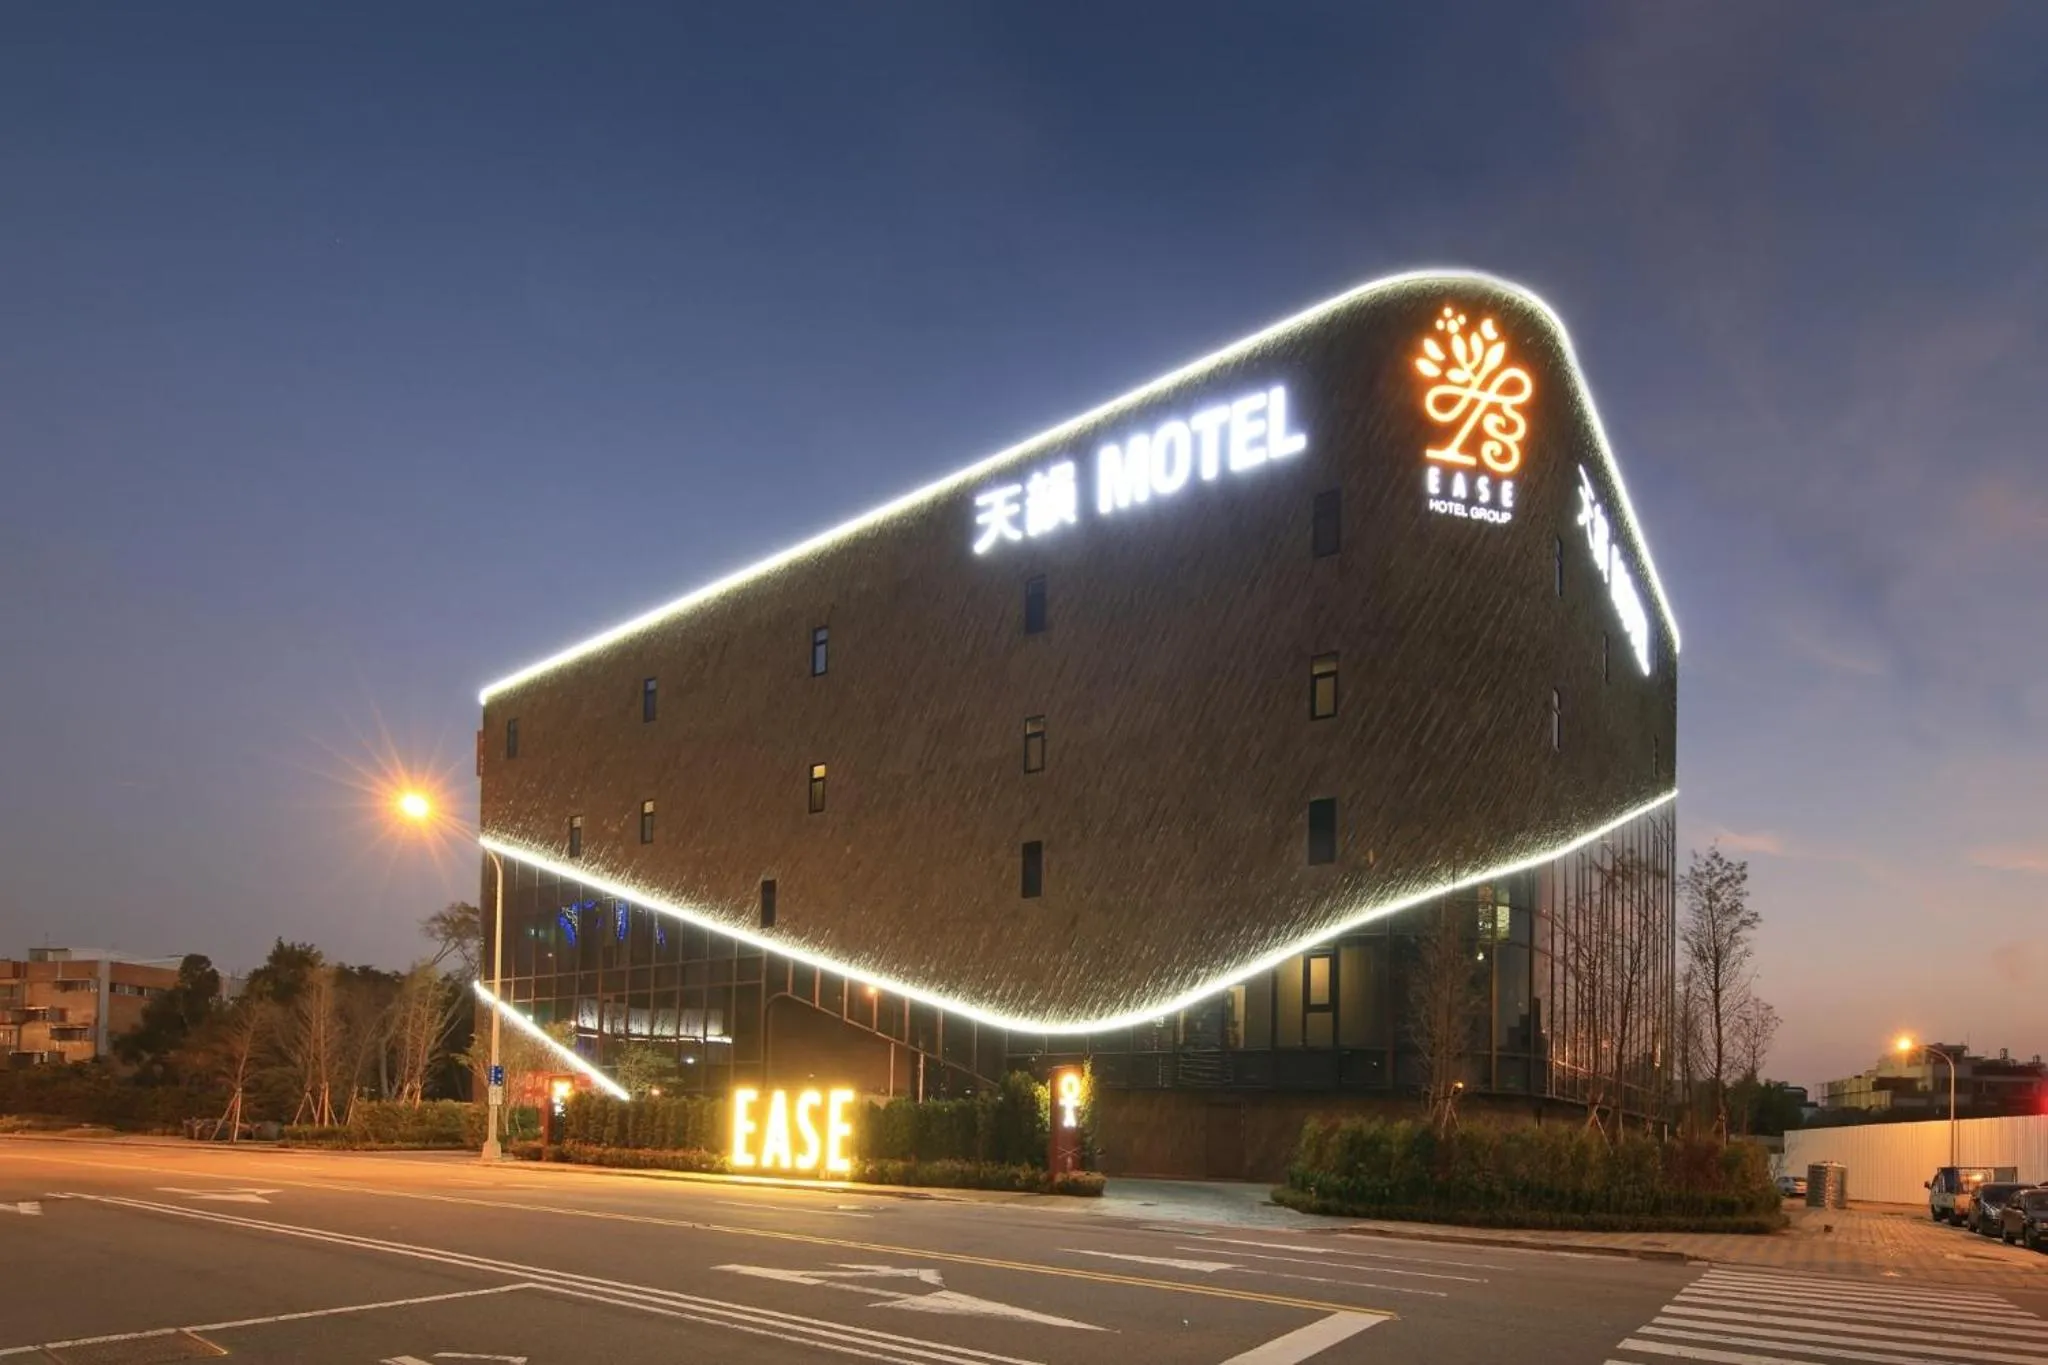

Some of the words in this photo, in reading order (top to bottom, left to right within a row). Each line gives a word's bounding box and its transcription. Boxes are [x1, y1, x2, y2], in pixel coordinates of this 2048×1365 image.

[1097, 384, 1307, 515] MOTEL
[1427, 466, 1514, 508] EASE
[1428, 498, 1468, 517] HOTEL
[1469, 506, 1512, 524] GROUP
[732, 1087, 855, 1172] EASE
